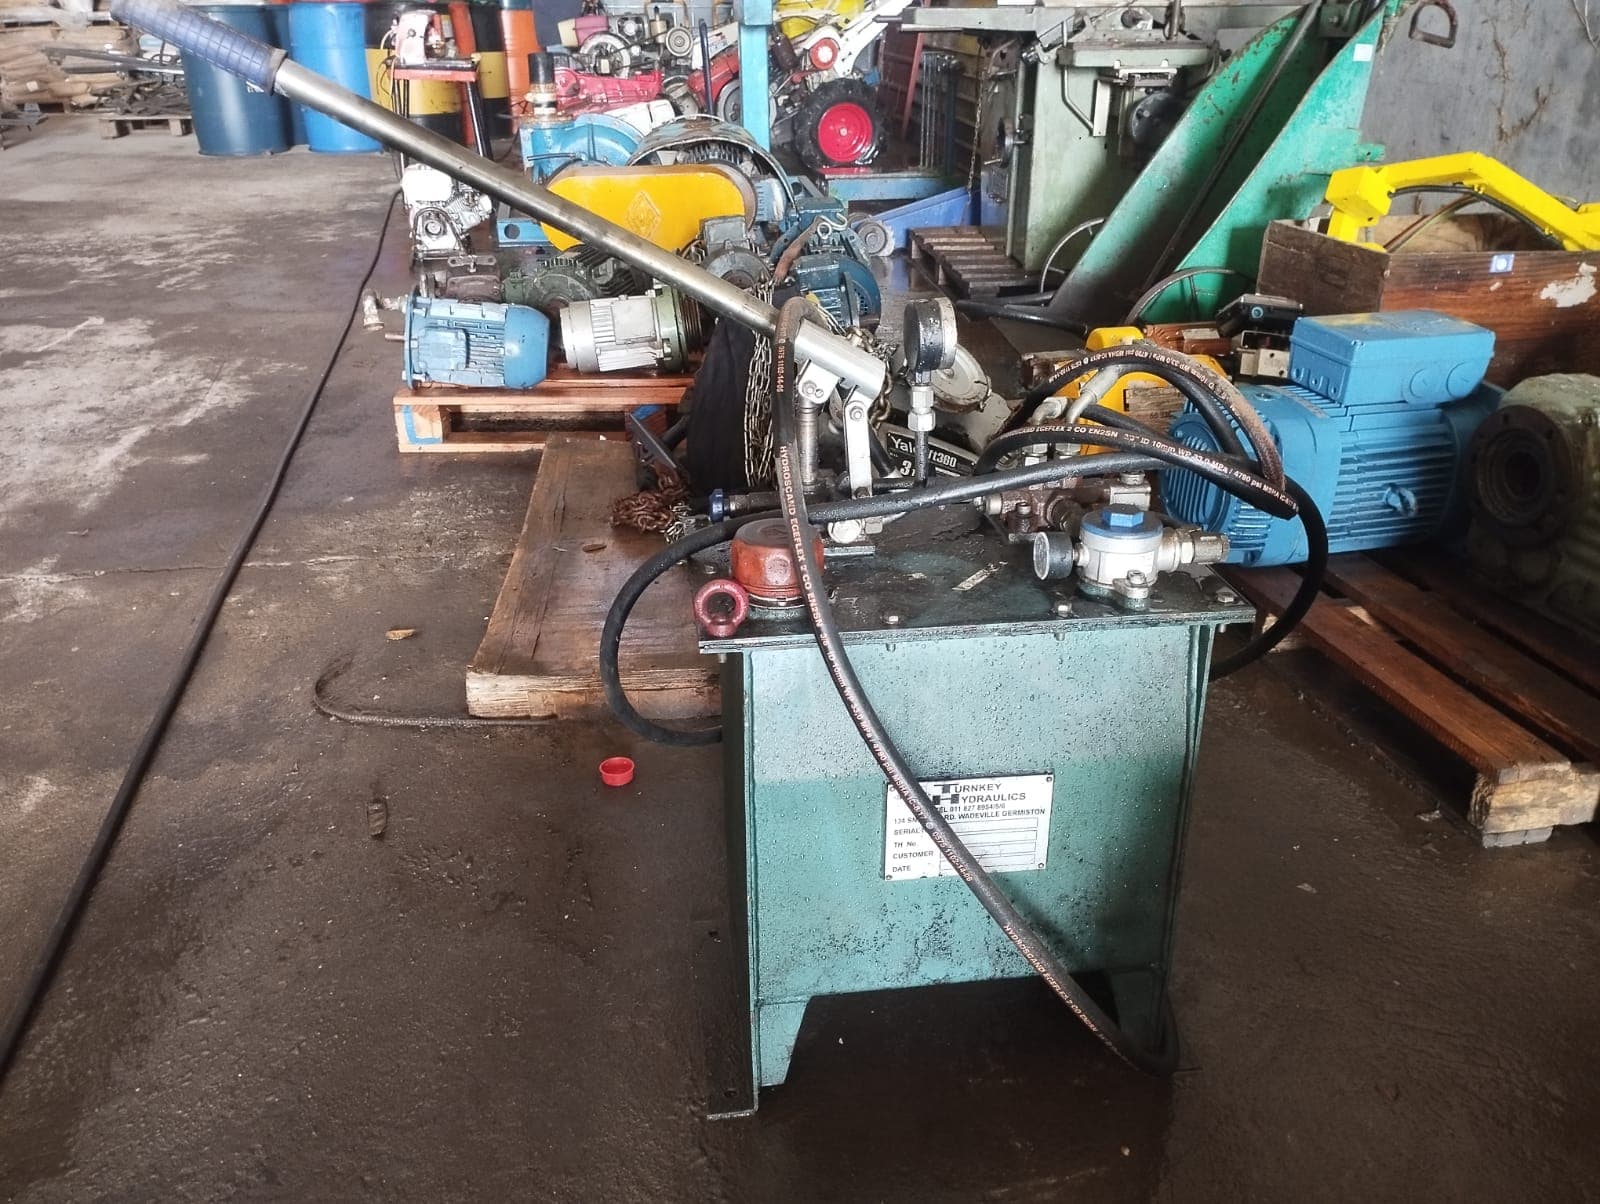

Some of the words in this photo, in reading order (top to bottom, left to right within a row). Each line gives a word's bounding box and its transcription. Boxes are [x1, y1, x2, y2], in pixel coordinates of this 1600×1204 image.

[1073, 426, 1086, 434] CO
[780, 445, 796, 516] HYDROSCAND
[790, 518, 806, 562] EGEFLEX
[802, 574, 813, 590] CO
[958, 810, 1000, 820] WADEVILLE
[1001, 808, 1046, 818] GERMISTON
[892, 850, 935, 860] CUSTOMER
[892, 865, 912, 873] DATE
